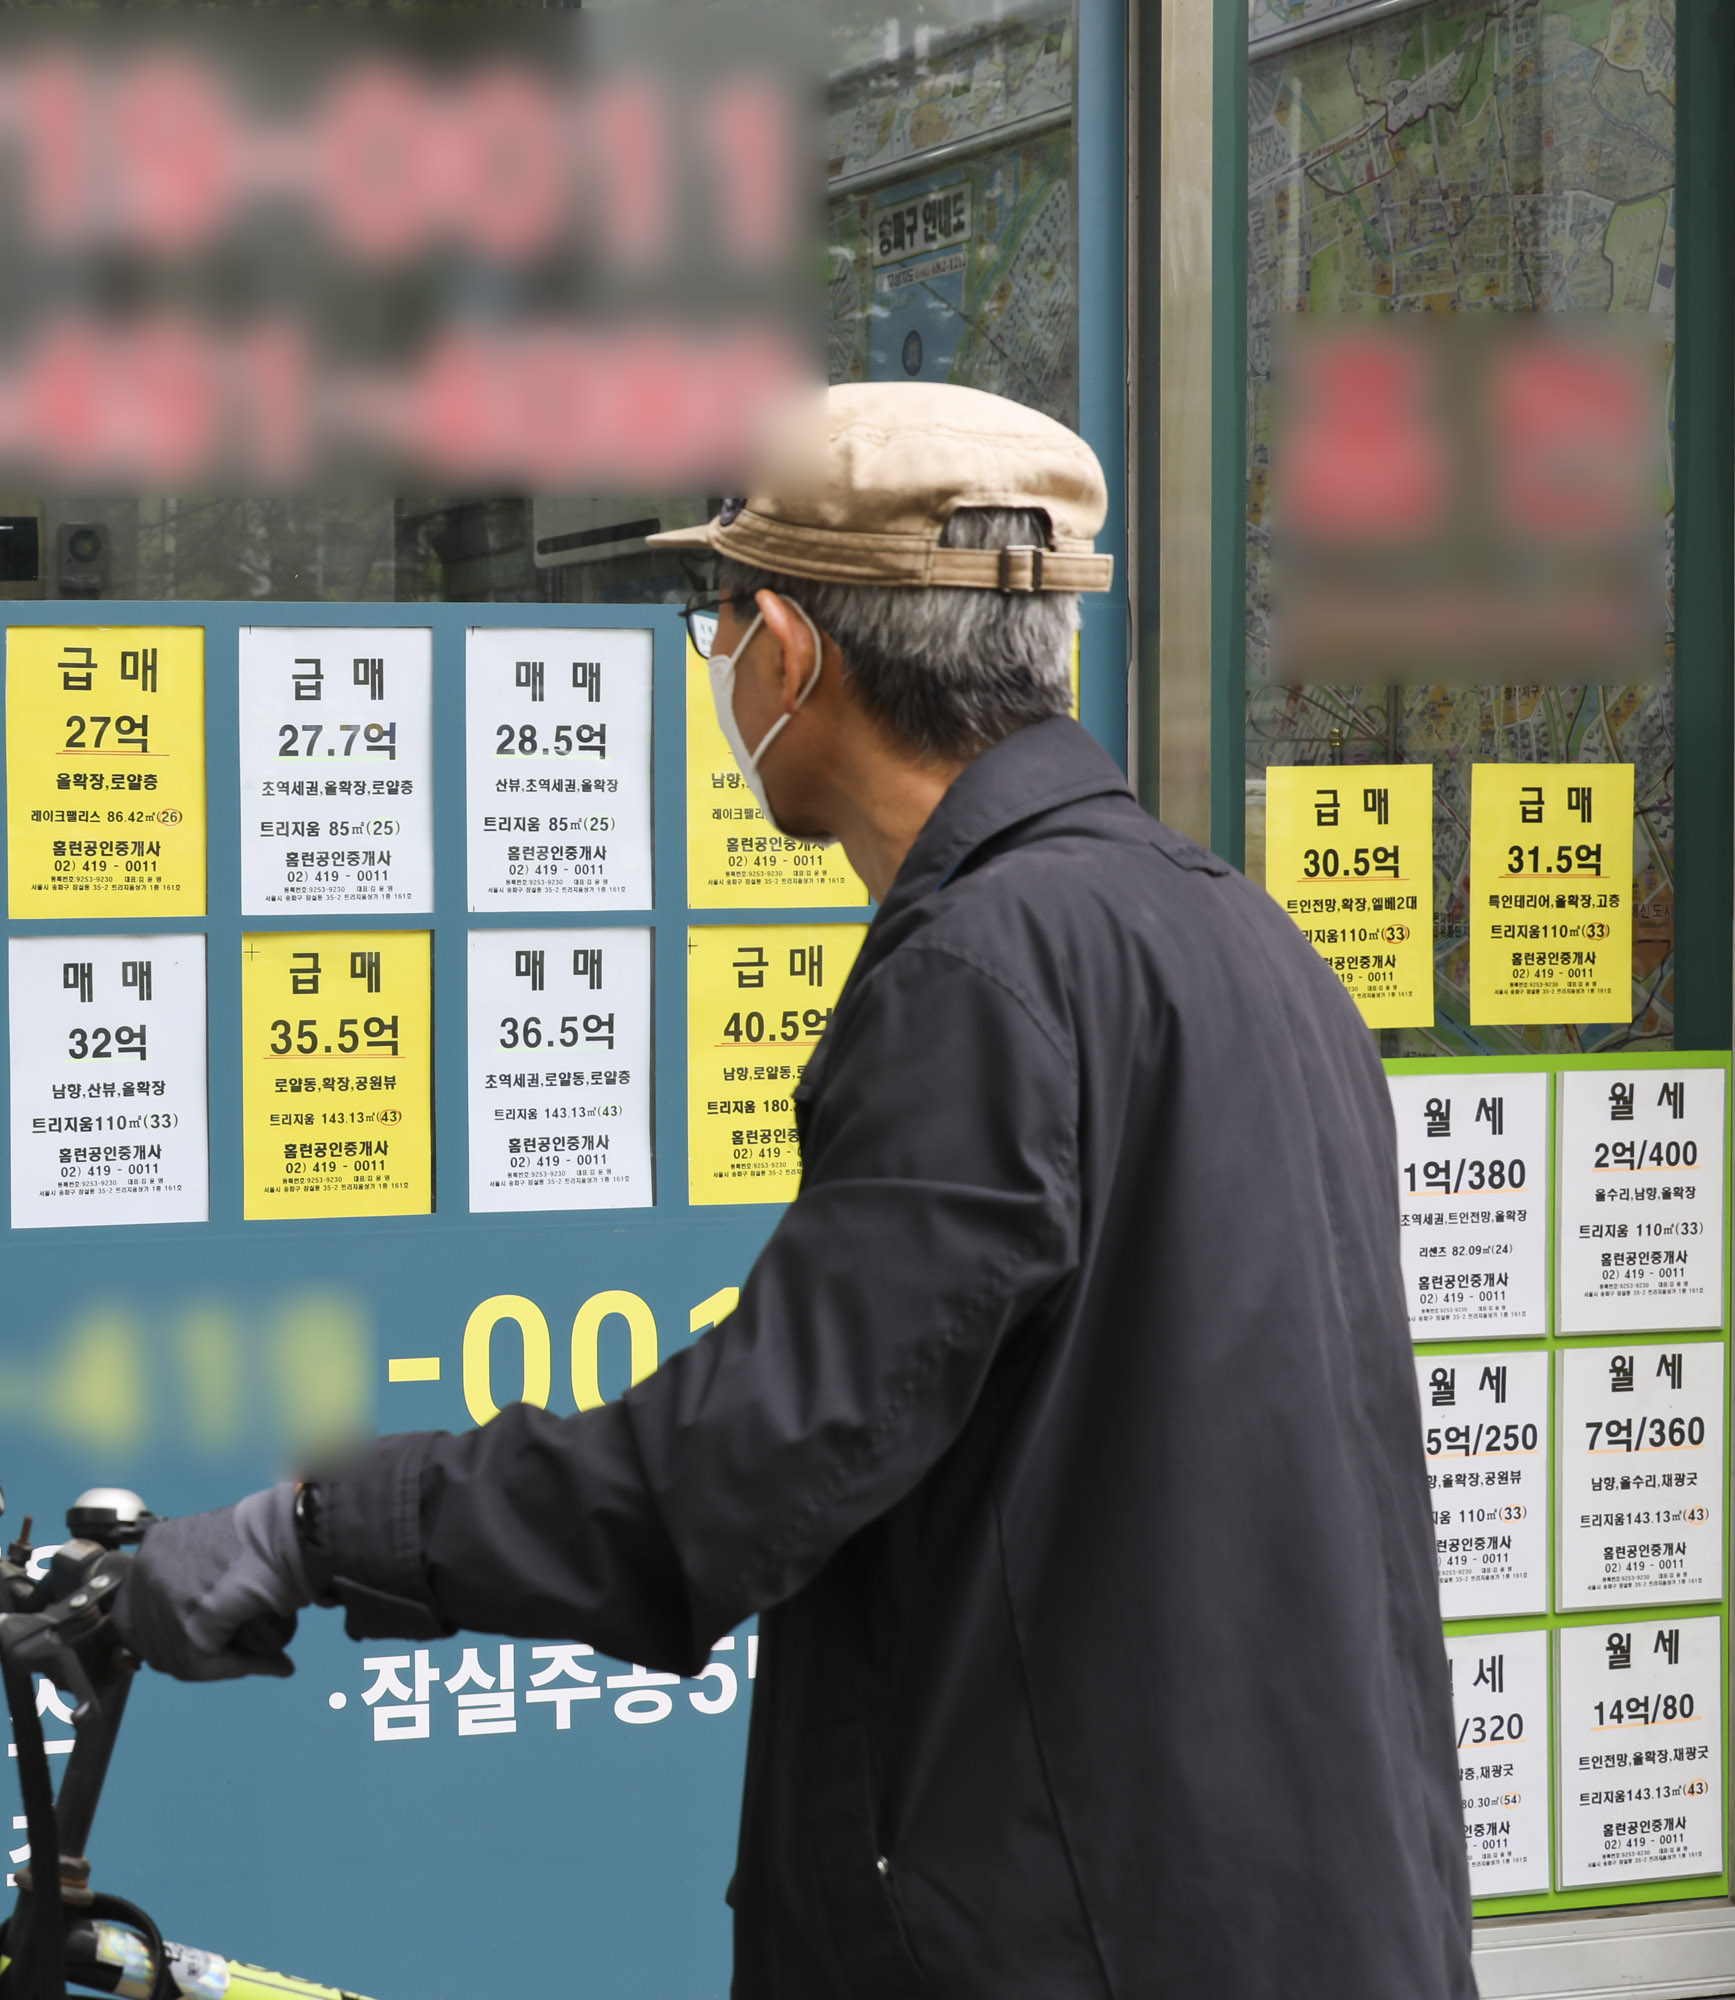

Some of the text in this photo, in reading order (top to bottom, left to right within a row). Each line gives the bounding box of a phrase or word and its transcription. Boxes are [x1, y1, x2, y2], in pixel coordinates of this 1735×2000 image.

[58, 647, 157, 692] 급 매
[292, 659, 383, 700] 급 매
[516, 662, 600, 702] 매 매
[66, 714, 148, 753] 27억
[279, 722, 396, 760] 27.7억
[497, 724, 606, 759] 28.5억
[56, 773, 157, 790] 올확장,로얄층
[262, 780, 413, 796] 초역세권,올확장,로얄층
[496, 779, 618, 792] 산뷰,초역세권,올확장
[712, 808, 770, 821] 레이크팰리
[1315, 789, 1388, 826] 급 매
[1520, 787, 1591, 823] 급 매
[260, 821, 320, 837] 트리지움
[484, 817, 540, 832] 트리지움
[55, 860, 75, 871] 02)
[82, 861, 106, 871] 419
[126, 861, 156, 872] 0011
[729, 856, 747, 867] 02)
[754, 856, 776, 866] 419
[794, 855, 822, 866] 0011
[1304, 846, 1399, 878] 30.5억
[1508, 844, 1601, 876] 31.5억
[288, 871, 308, 882] 02)
[315, 871, 338, 881] 419
[357, 870, 387, 881] 0011
[1303, 926, 1410, 945] 리지움110㎡(33)
[63, 961, 151, 1002] 매 매
[290, 952, 380, 994] 급 매
[516, 949, 602, 991] 매 매
[733, 945, 822, 988] 급 매
[1338, 972, 1353, 982] 19
[1368, 972, 1392, 982] 0011
[1513, 969, 1529, 978] 02)
[1535, 969, 1553, 978] 419
[1568, 968, 1592, 978] 0011
[69, 1025, 146, 1060] 32억
[270, 1016, 398, 1056] 35.5억
[500, 1013, 614, 1049] 36.5억
[53, 1081, 165, 1099] 남향,산뷰,올확장
[275, 1076, 396, 1092] 로얄동,확장,공원뷰
[485, 1070, 630, 1088] 초역세권,로얄동,로얄층
[495, 1109, 537, 1120] 트리지움
[707, 1100, 797, 1114] 트리지움 180.
[1609, 1082, 1684, 1120] 월 세
[270, 1114, 314, 1125] 트리지움
[1424, 1097, 1503, 1137] 월 세
[286, 1163, 306, 1173] 02)
[313, 1161, 336, 1172] 419
[354, 1160, 384, 1171] 0011
[1595, 1140, 1697, 1170] 2억/400
[1404, 1159, 1525, 1194] 1억/380
[1579, 1224, 1628, 1238] 트리지움
[1602, 1270, 1619, 1280] 02)
[1625, 1269, 1644, 1279] 419
[1659, 1267, 1684, 1278] 0011
[1420, 1294, 1437, 1304] 02)
[1444, 1292, 1463, 1303] 419
[1479, 1291, 1505, 1301] 0011
[388, 1286, 740, 1428] -00
[1429, 1366, 1506, 1406] 월 세
[1609, 1354, 1682, 1392] 월 세
[1586, 1417, 1704, 1452] 7억/360
[1427, 1470, 1521, 1490] 향,올확장,공원뷰
[1436, 1536, 1511, 1551] 런공인중개사
[1606, 1629, 1679, 1669] 월 세
[361, 1636, 758, 1742] 잠실주공5
[1473, 1655, 1503, 1693] 세
[1594, 1694, 1694, 1725] 14억/80
[1458, 1713, 1523, 1748] /320
[1459, 1764, 1514, 1782] 층,채광굿
[1463, 1794, 1521, 1809] 80.30㎡(54)
[1605, 1840, 1621, 1850] 02)
[1626, 1837, 1645, 1847] 419
[1660, 1833, 1683, 1844] 0011
